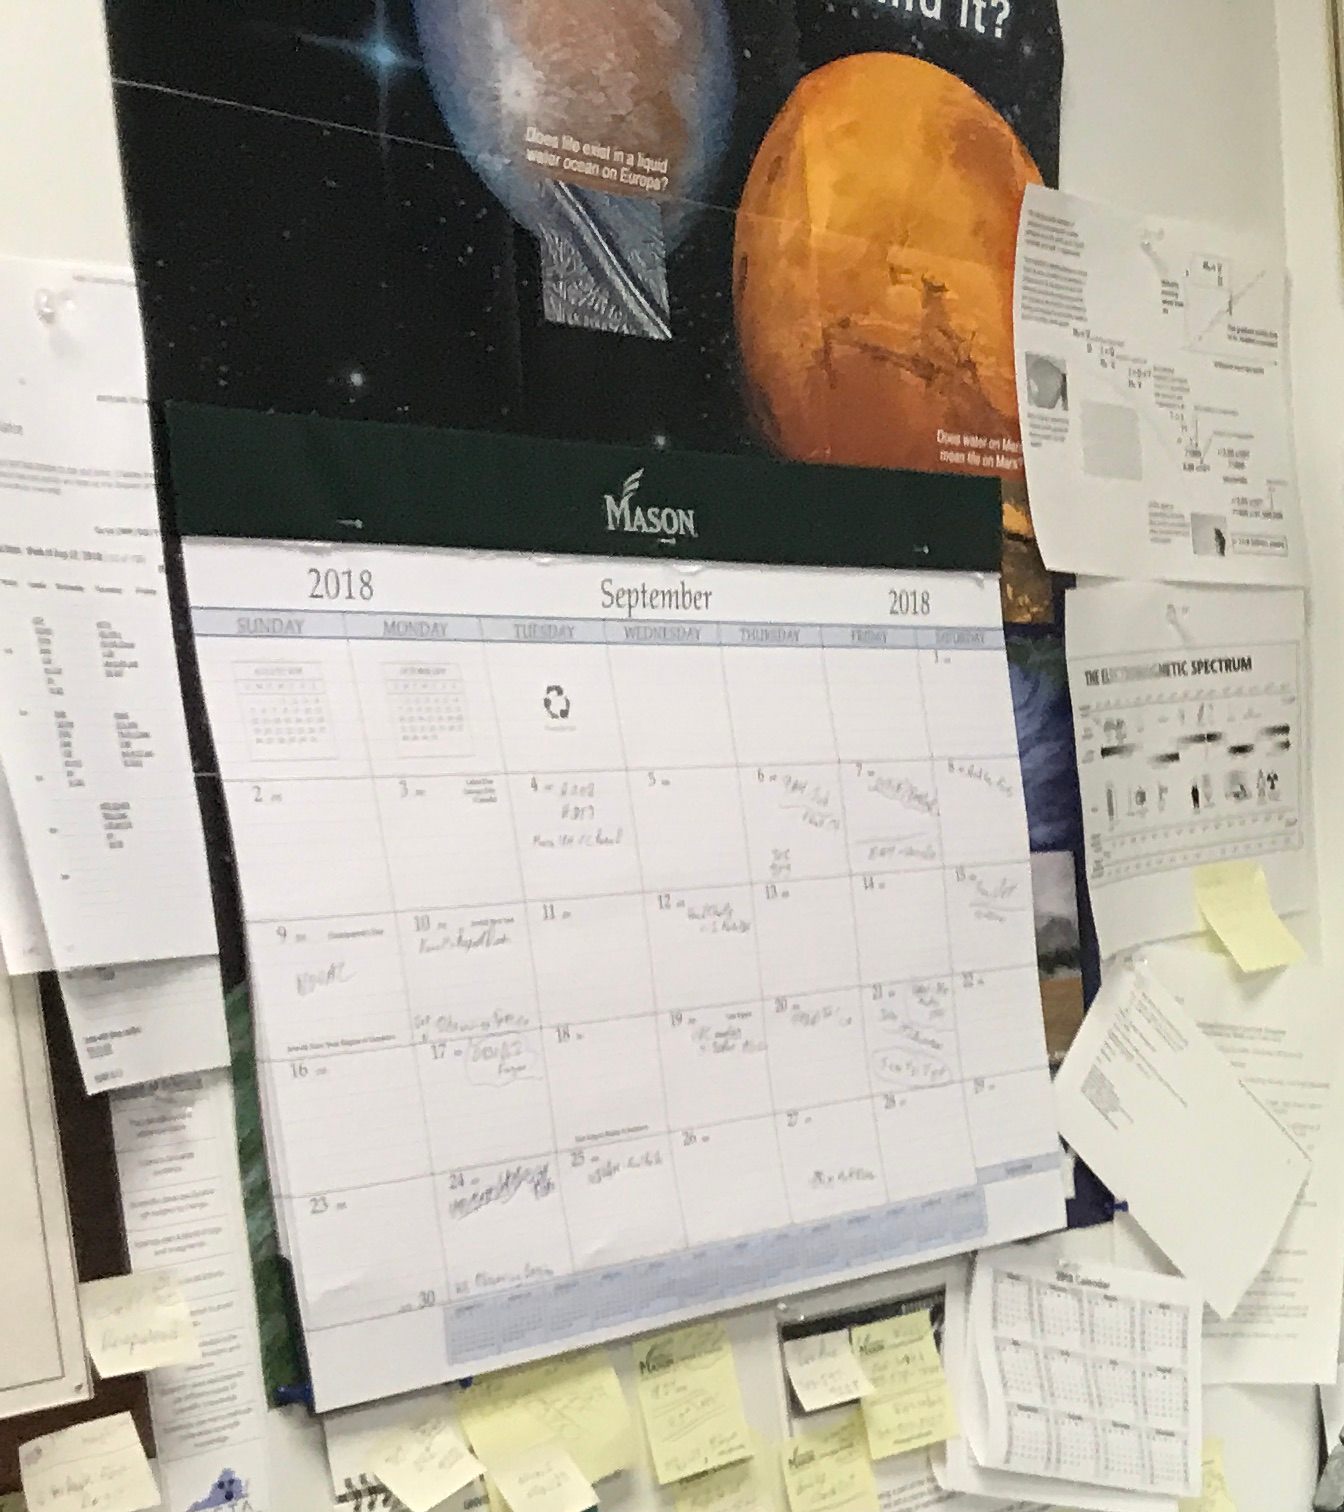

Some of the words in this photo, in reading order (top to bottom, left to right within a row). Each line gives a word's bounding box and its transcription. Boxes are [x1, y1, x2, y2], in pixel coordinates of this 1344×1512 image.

[525, 126, 559, 148] Does
[562, 134, 580, 153] life
[582, 143, 611, 161] exist
[614, 147, 623, 162] in
[637, 152, 668, 173] liquid
[526, 149, 561, 167] water
[563, 157, 600, 176] ocean
[602, 167, 617, 180] on
[620, 167, 669, 191] Europa?
[604, 495, 699, 538] MASON
[307, 567, 375, 601] 2018
[600, 578, 713, 619] September
[889, 588, 931, 616] 2018
[236, 618, 304, 635] SUNDAY
[383, 621, 448, 638] MONDAY
[513, 623, 575, 641] TUESDAY
[624, 626, 701, 642] WEDNESDAY
[740, 628, 800, 643] THURSDAY
[850, 630, 889, 645] FRIDAY
[935, 631, 985, 645] SATURDAY
[1191, 655, 1252, 677] SPECTRUM
